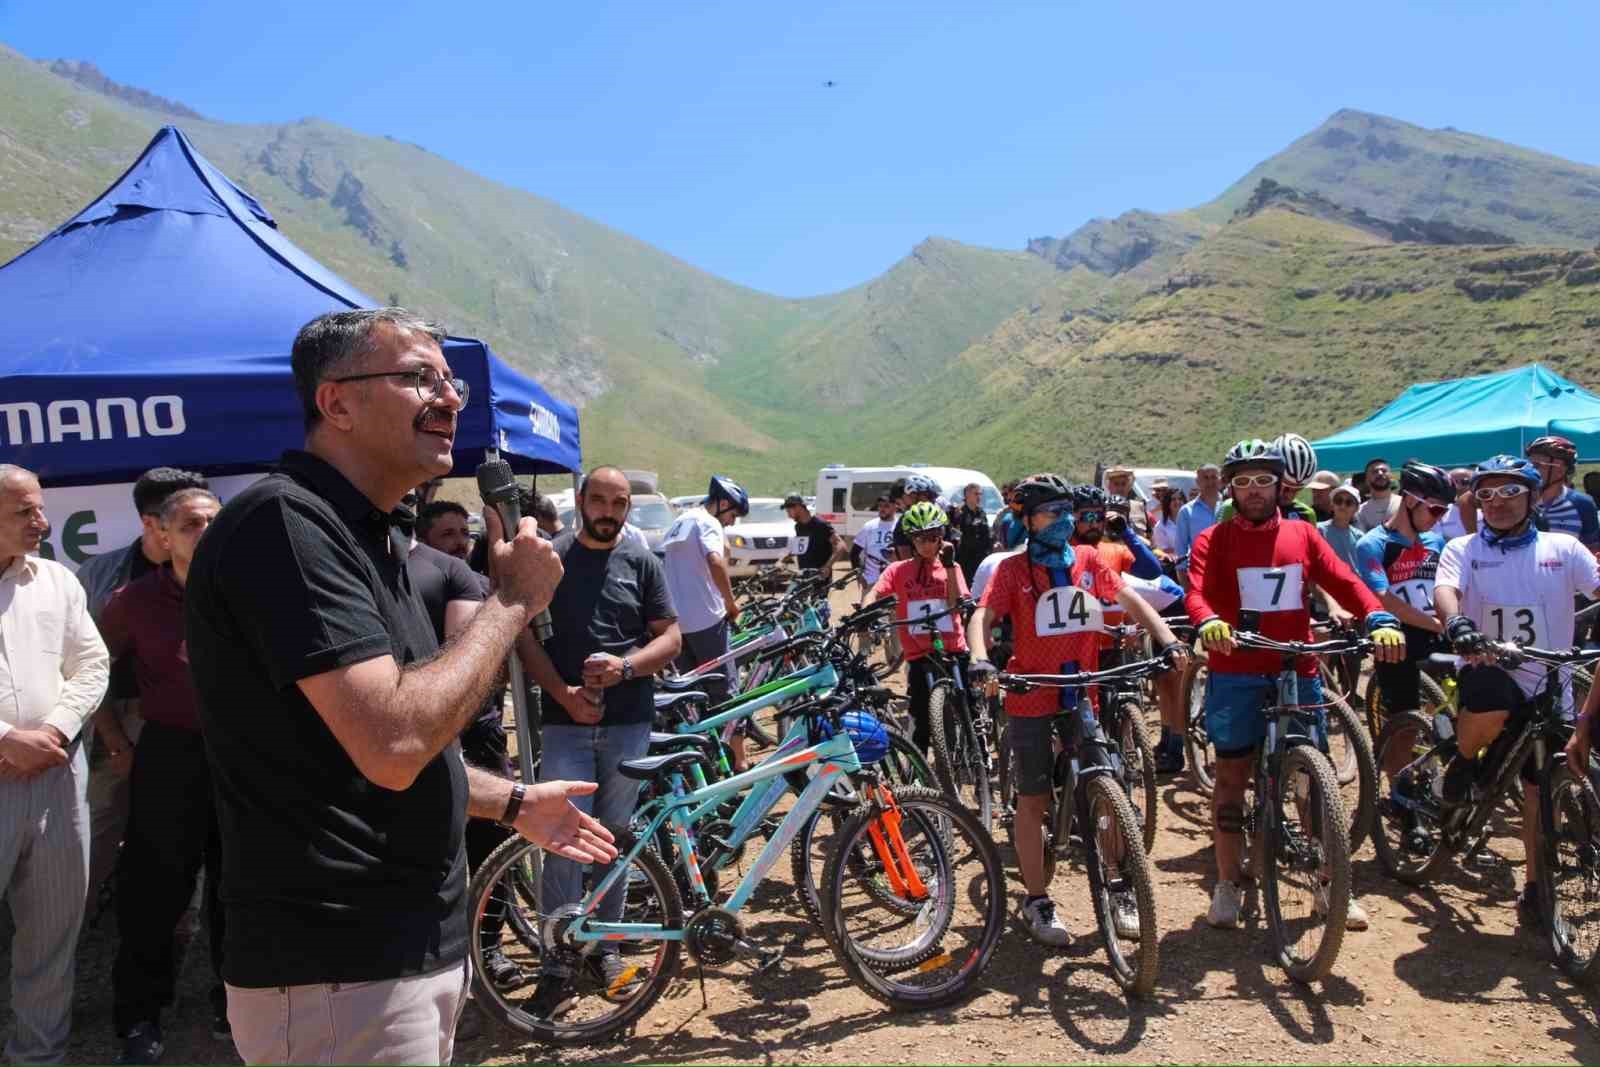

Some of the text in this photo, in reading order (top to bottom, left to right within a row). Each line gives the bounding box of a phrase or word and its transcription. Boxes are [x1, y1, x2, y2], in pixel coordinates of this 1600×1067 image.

[0, 395, 186, 445] MANO
[1263, 572, 1286, 606] 7
[1395, 583, 1434, 612] 11
[1046, 591, 1090, 629] 14
[1491, 608, 1536, 648] 13
